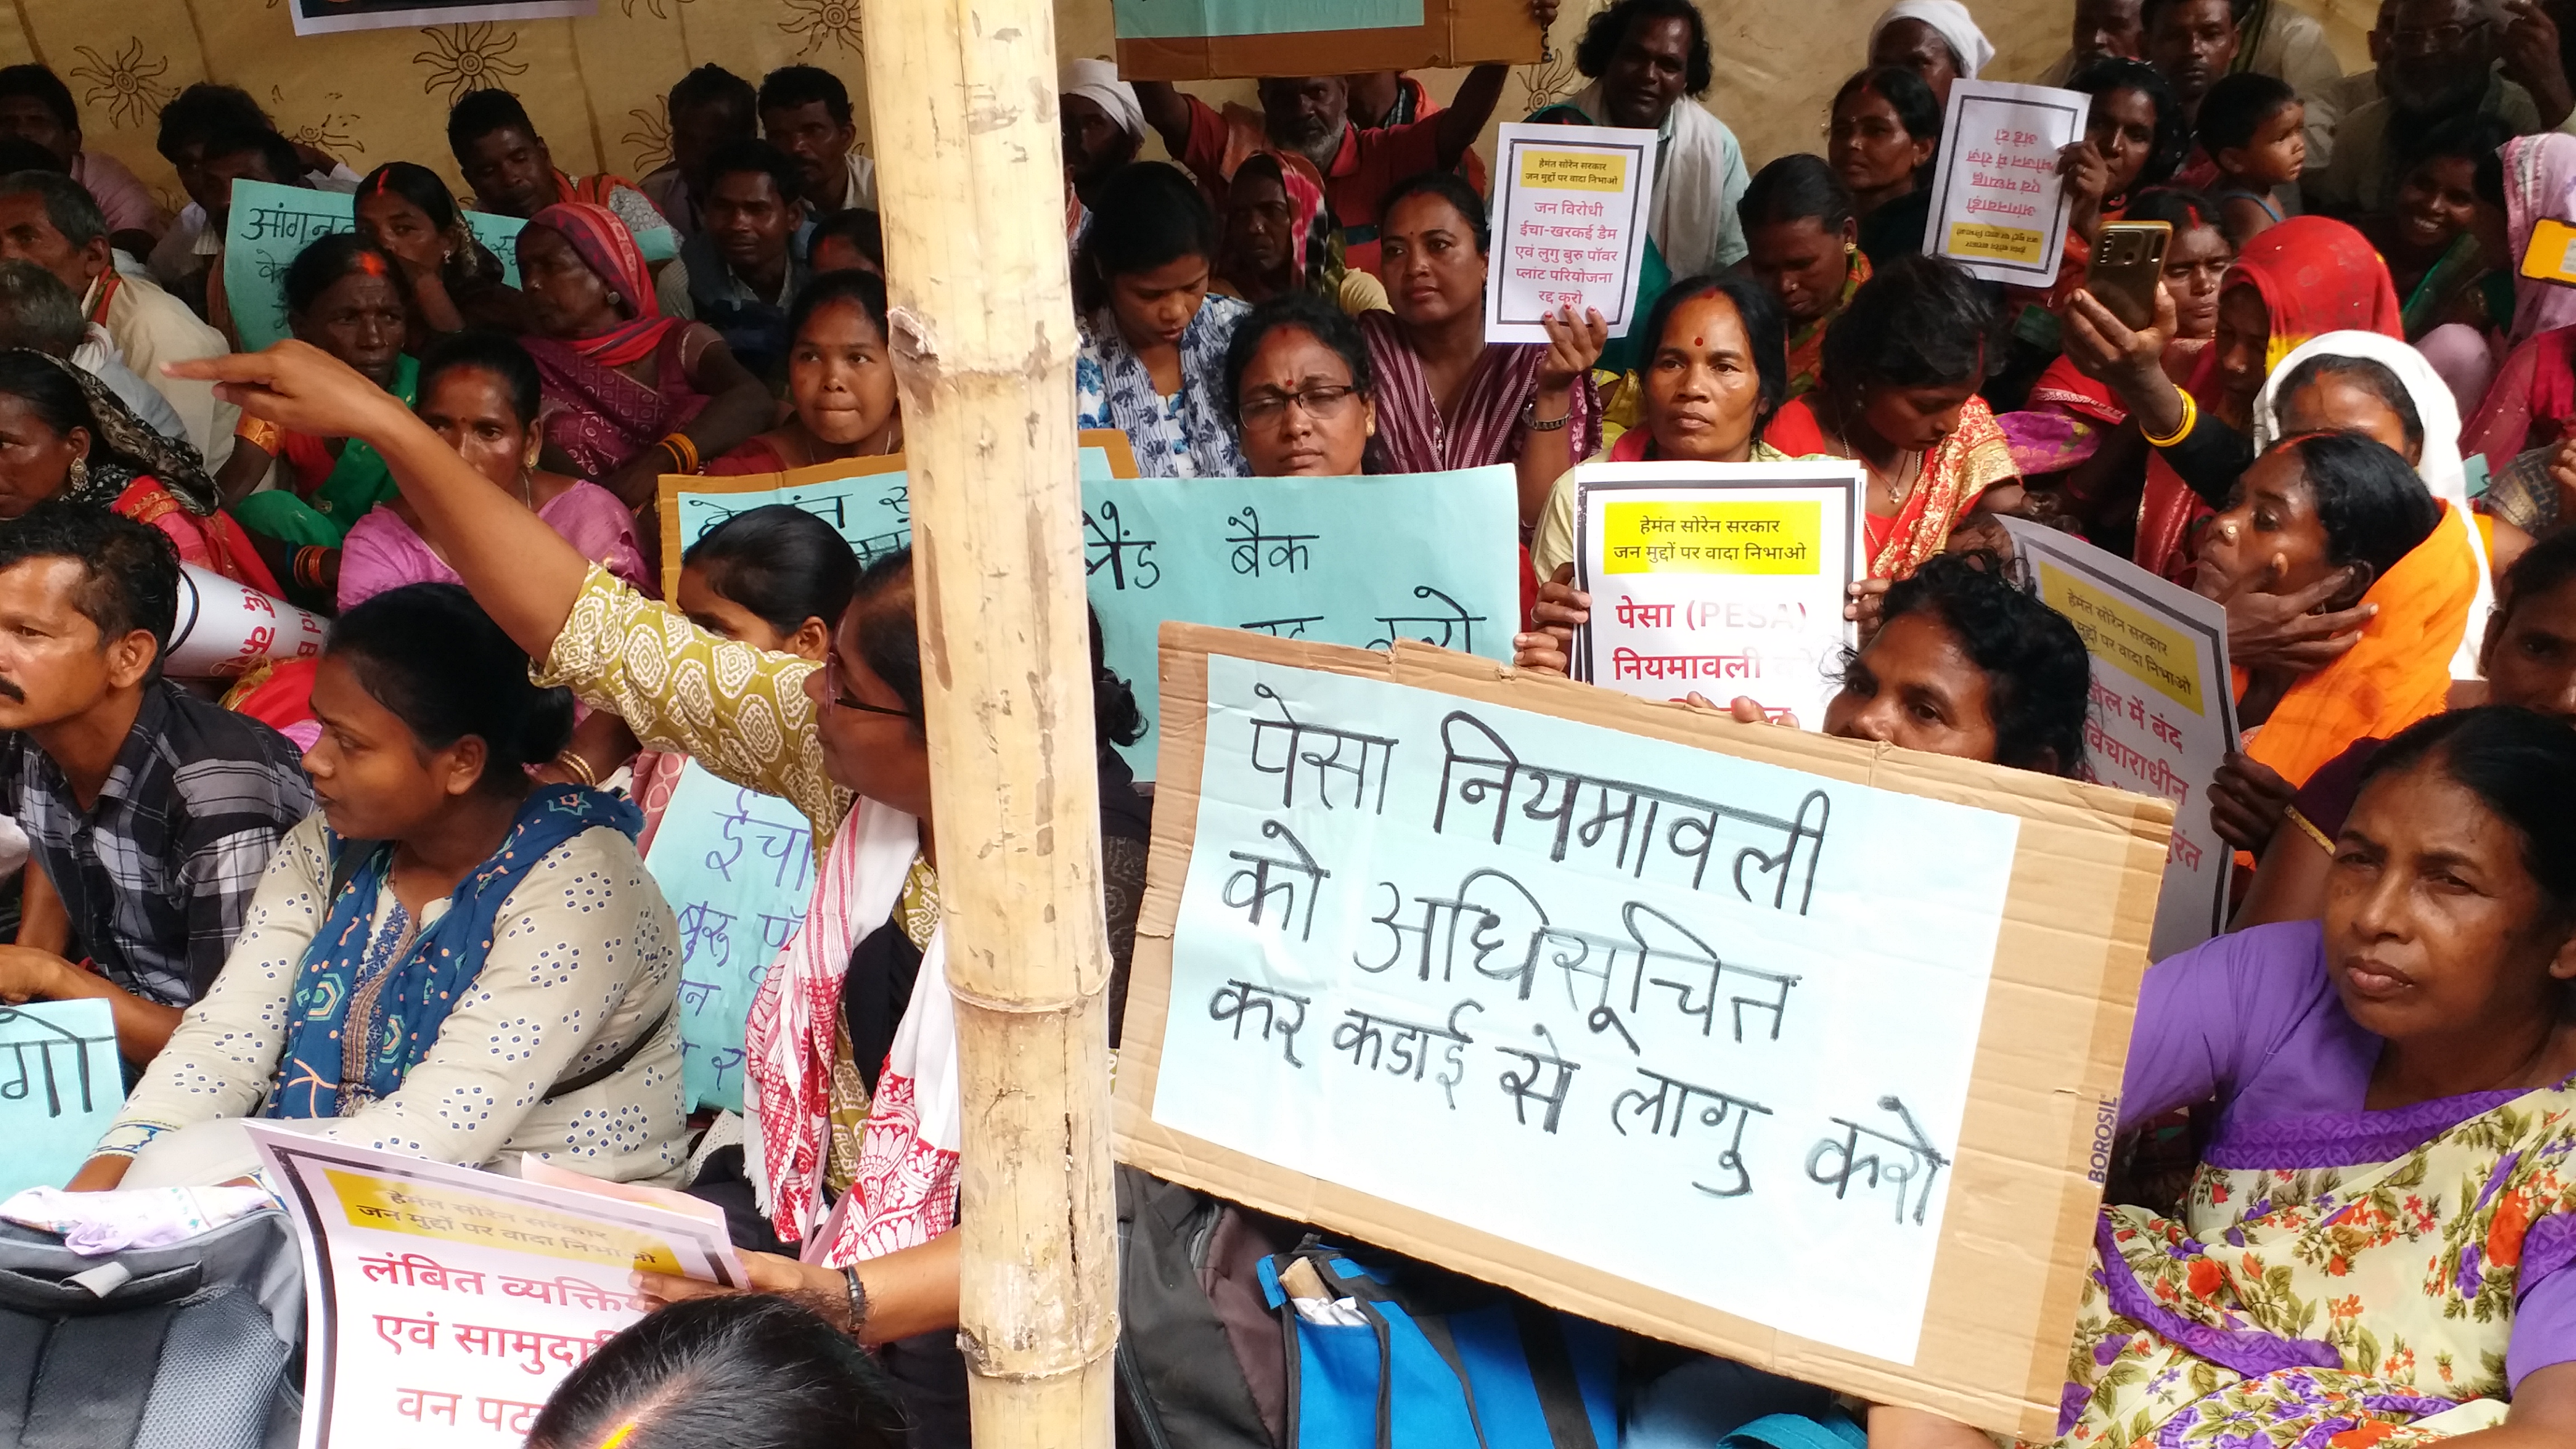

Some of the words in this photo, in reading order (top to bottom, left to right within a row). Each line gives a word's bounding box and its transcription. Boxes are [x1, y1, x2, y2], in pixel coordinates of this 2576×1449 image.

[1539, 158, 1556, 168] हेमंत
[1559, 159, 1578, 169] सोरेन
[1996, 153, 2008, 168] में
[1588, 173, 1618, 185] निभाओ
[2020, 179, 2040, 195] एवं
[1535, 202, 1558, 214] जन
[1561, 200, 1604, 217] विरोधी
[1966, 196, 2036, 218] आंगनवाड़ी
[1520, 220, 1593, 240] ईचा-खरकई
[1597, 225, 1618, 239] डैम
[1515, 244, 1535, 259] एवं
[1538, 248, 1560, 263] लुगु
[1563, 249, 1584, 264] बुरु
[1588, 247, 1618, 262] पॉवर
[1516, 266, 1546, 280] प्लांट
[1550, 267, 1613, 283] परियोजना
[1538, 291, 1555, 304] रद्द
[1558, 290, 1583, 304] करो
[1640, 515, 1676, 535] हेमंत
[1680, 515, 1722, 533] सोरेन
[1726, 519, 1781, 533] सरकार
[1613, 546, 1641, 560] जन
[1646, 541, 1676, 564] मुद्दों
[1680, 546, 1701, 560] पर
[1705, 546, 1740, 561] वादा
[1745, 542, 1807, 560] निभाओ
[1615, 595, 1675, 629] पेसा
[1686, 600, 1807, 632] (PESA)
[2067, 588, 2092, 615] हेमंत
[2095, 606, 2125, 633] सोरेन
[2127, 623, 2168, 656] सरकार
[1612, 646, 1763, 681] नियमावली
[2118, 643, 2143, 667] वादा
[2144, 655, 2191, 695] निभाओ
[2127, 695, 2145, 730] में
[2149, 712, 2183, 754] बंद
[2083, 716, 2190, 806] विचाराधीन
[1250, 682, 1399, 815] पेसा
[1433, 710, 1830, 916] नियमावली
[1222, 818, 1330, 943] को
[1353, 866, 1803, 1055] अधिसूचित
[1209, 978, 1311, 1069] कर
[1494, 1023, 1581, 1135] से
[1804, 1094, 1951, 1227] करो
[2087, 1096, 2118, 1183] BOROSIL
[356, 1204, 401, 1221] जन
[461, 1222, 494, 1237] पर
[500, 1229, 554, 1247] वादा
[358, 1251, 485, 1295] लंबित
[373, 1311, 439, 1355] एवं
[397, 1387, 462, 1427] वन
